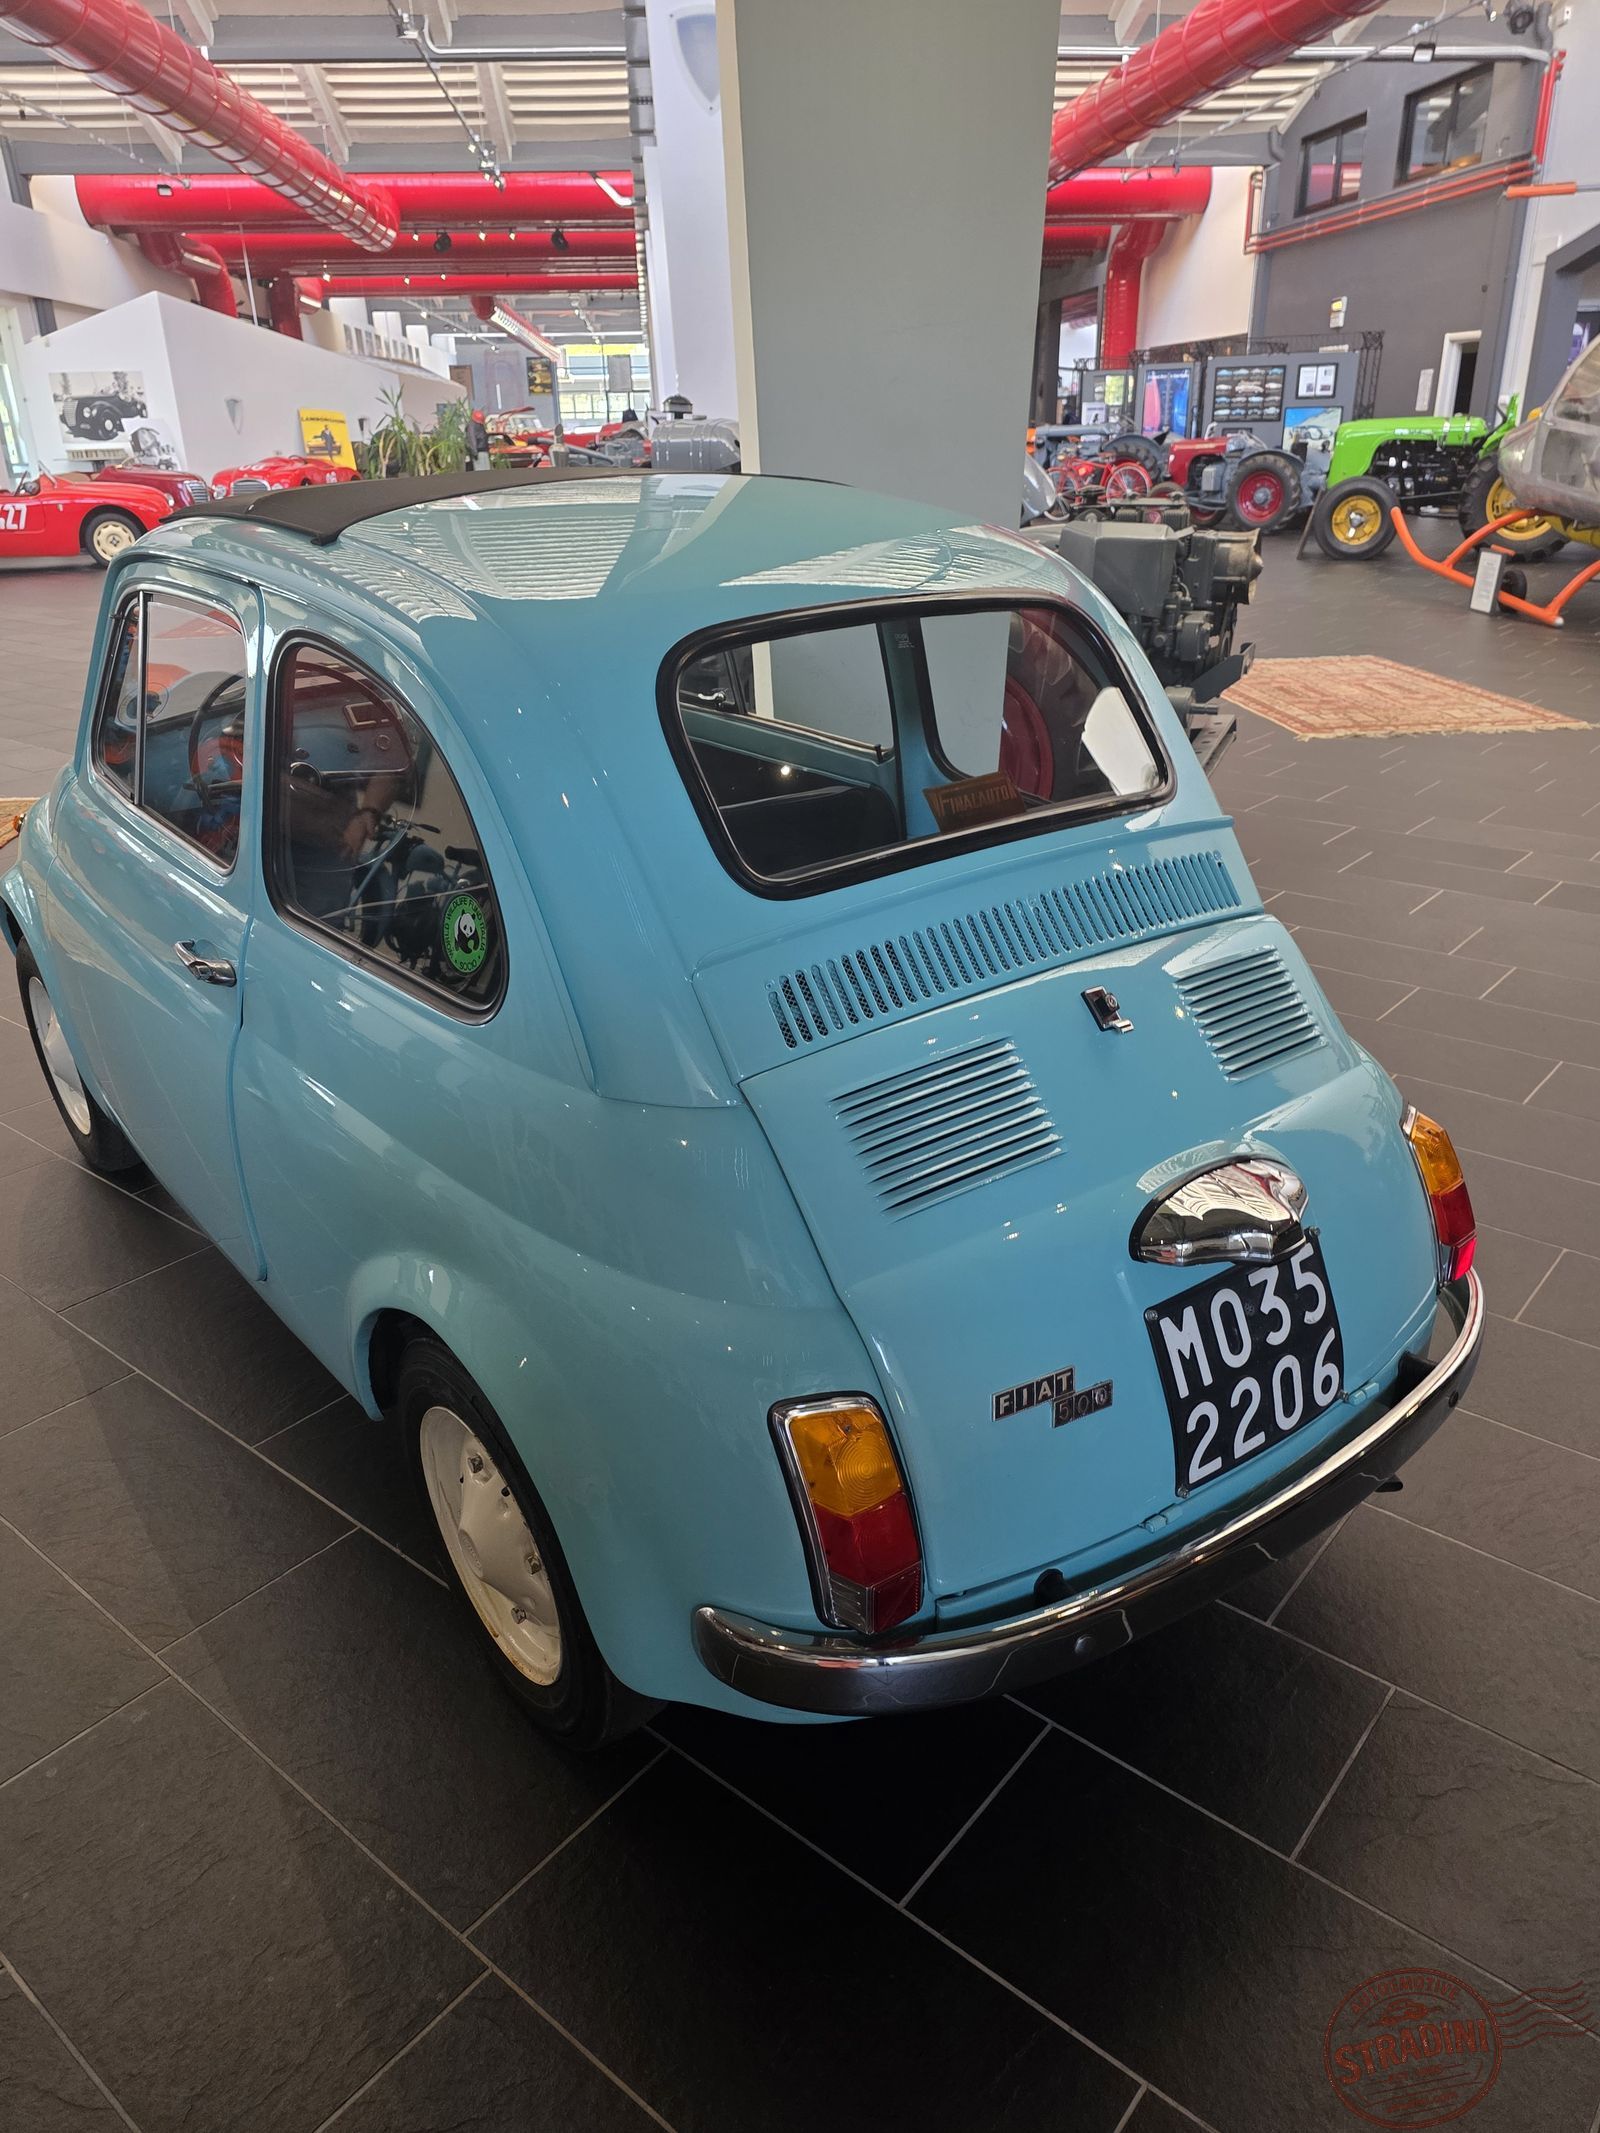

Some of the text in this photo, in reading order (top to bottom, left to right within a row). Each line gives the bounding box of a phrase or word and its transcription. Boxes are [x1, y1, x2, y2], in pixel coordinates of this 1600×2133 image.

[999, 1371, 1072, 1416] FIAT
[1059, 1386, 1108, 1421] 500
[1186, 1327, 1340, 1485] 2206
